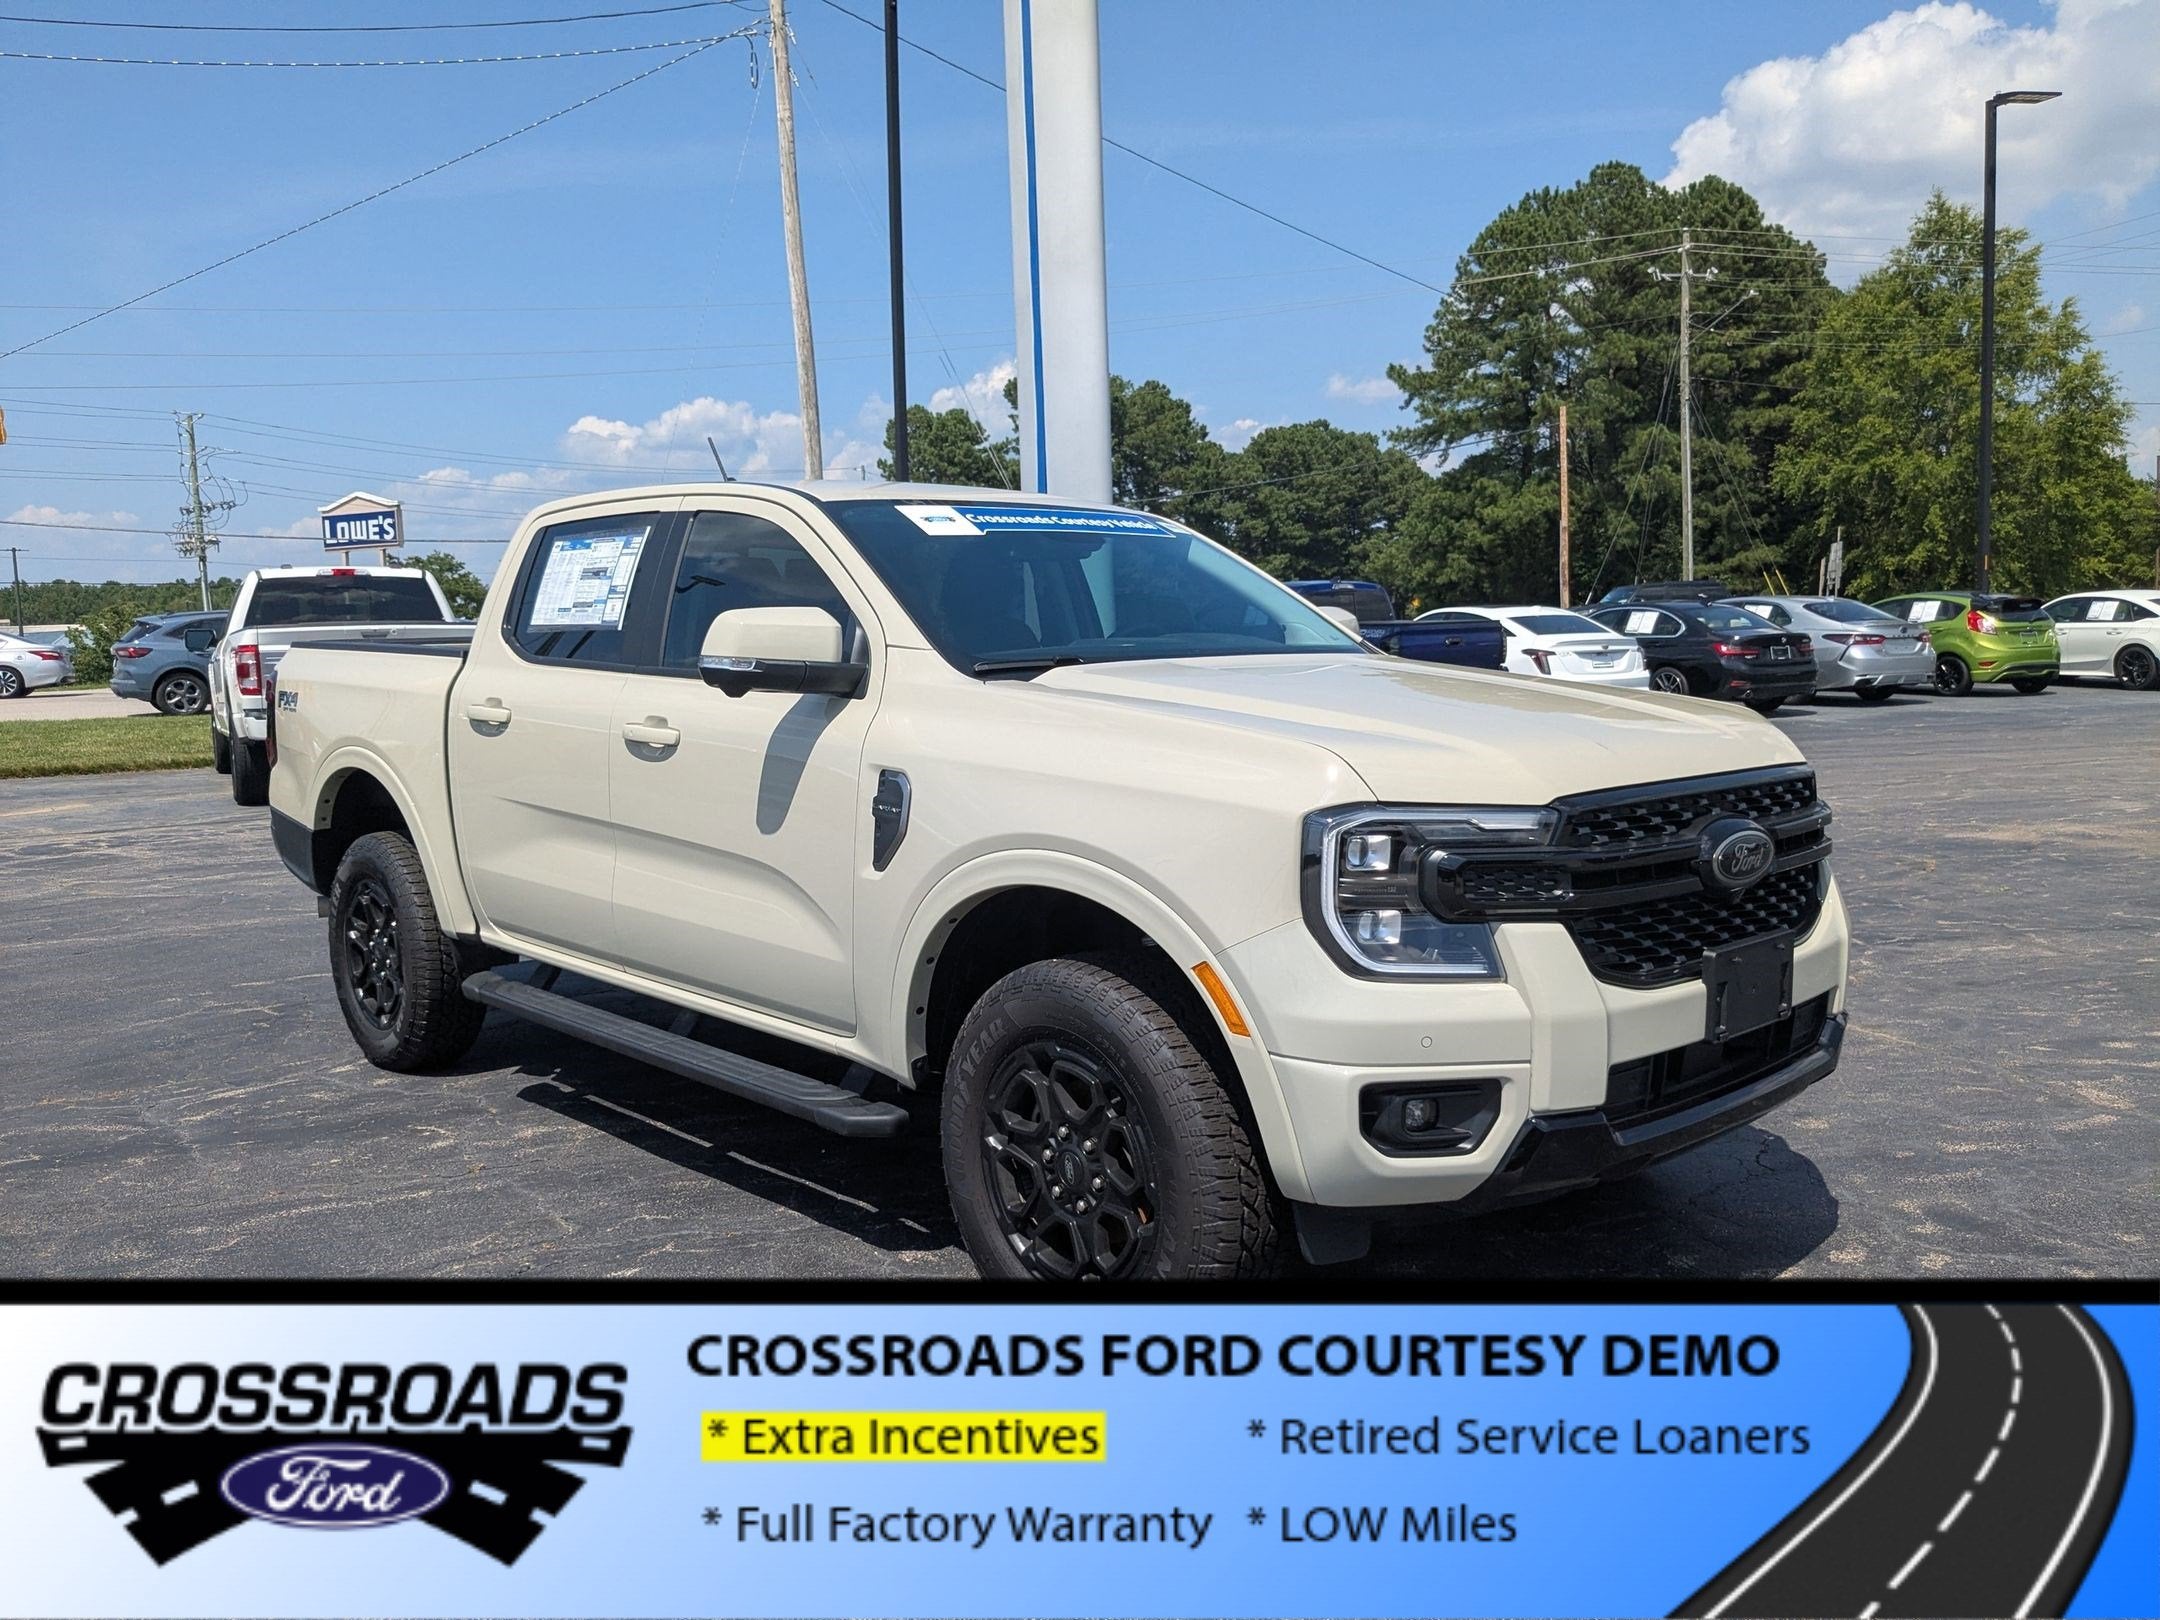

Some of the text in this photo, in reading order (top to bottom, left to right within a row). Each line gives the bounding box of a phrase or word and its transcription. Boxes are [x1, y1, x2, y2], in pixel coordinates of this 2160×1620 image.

[324, 515, 395, 544] LOWE'S
[965, 513, 1054, 524] Crossroads
[1051, 516, 1115, 528] Courtesy
[278, 690, 299, 708] FX4
[1731, 843, 1764, 873] Ford
